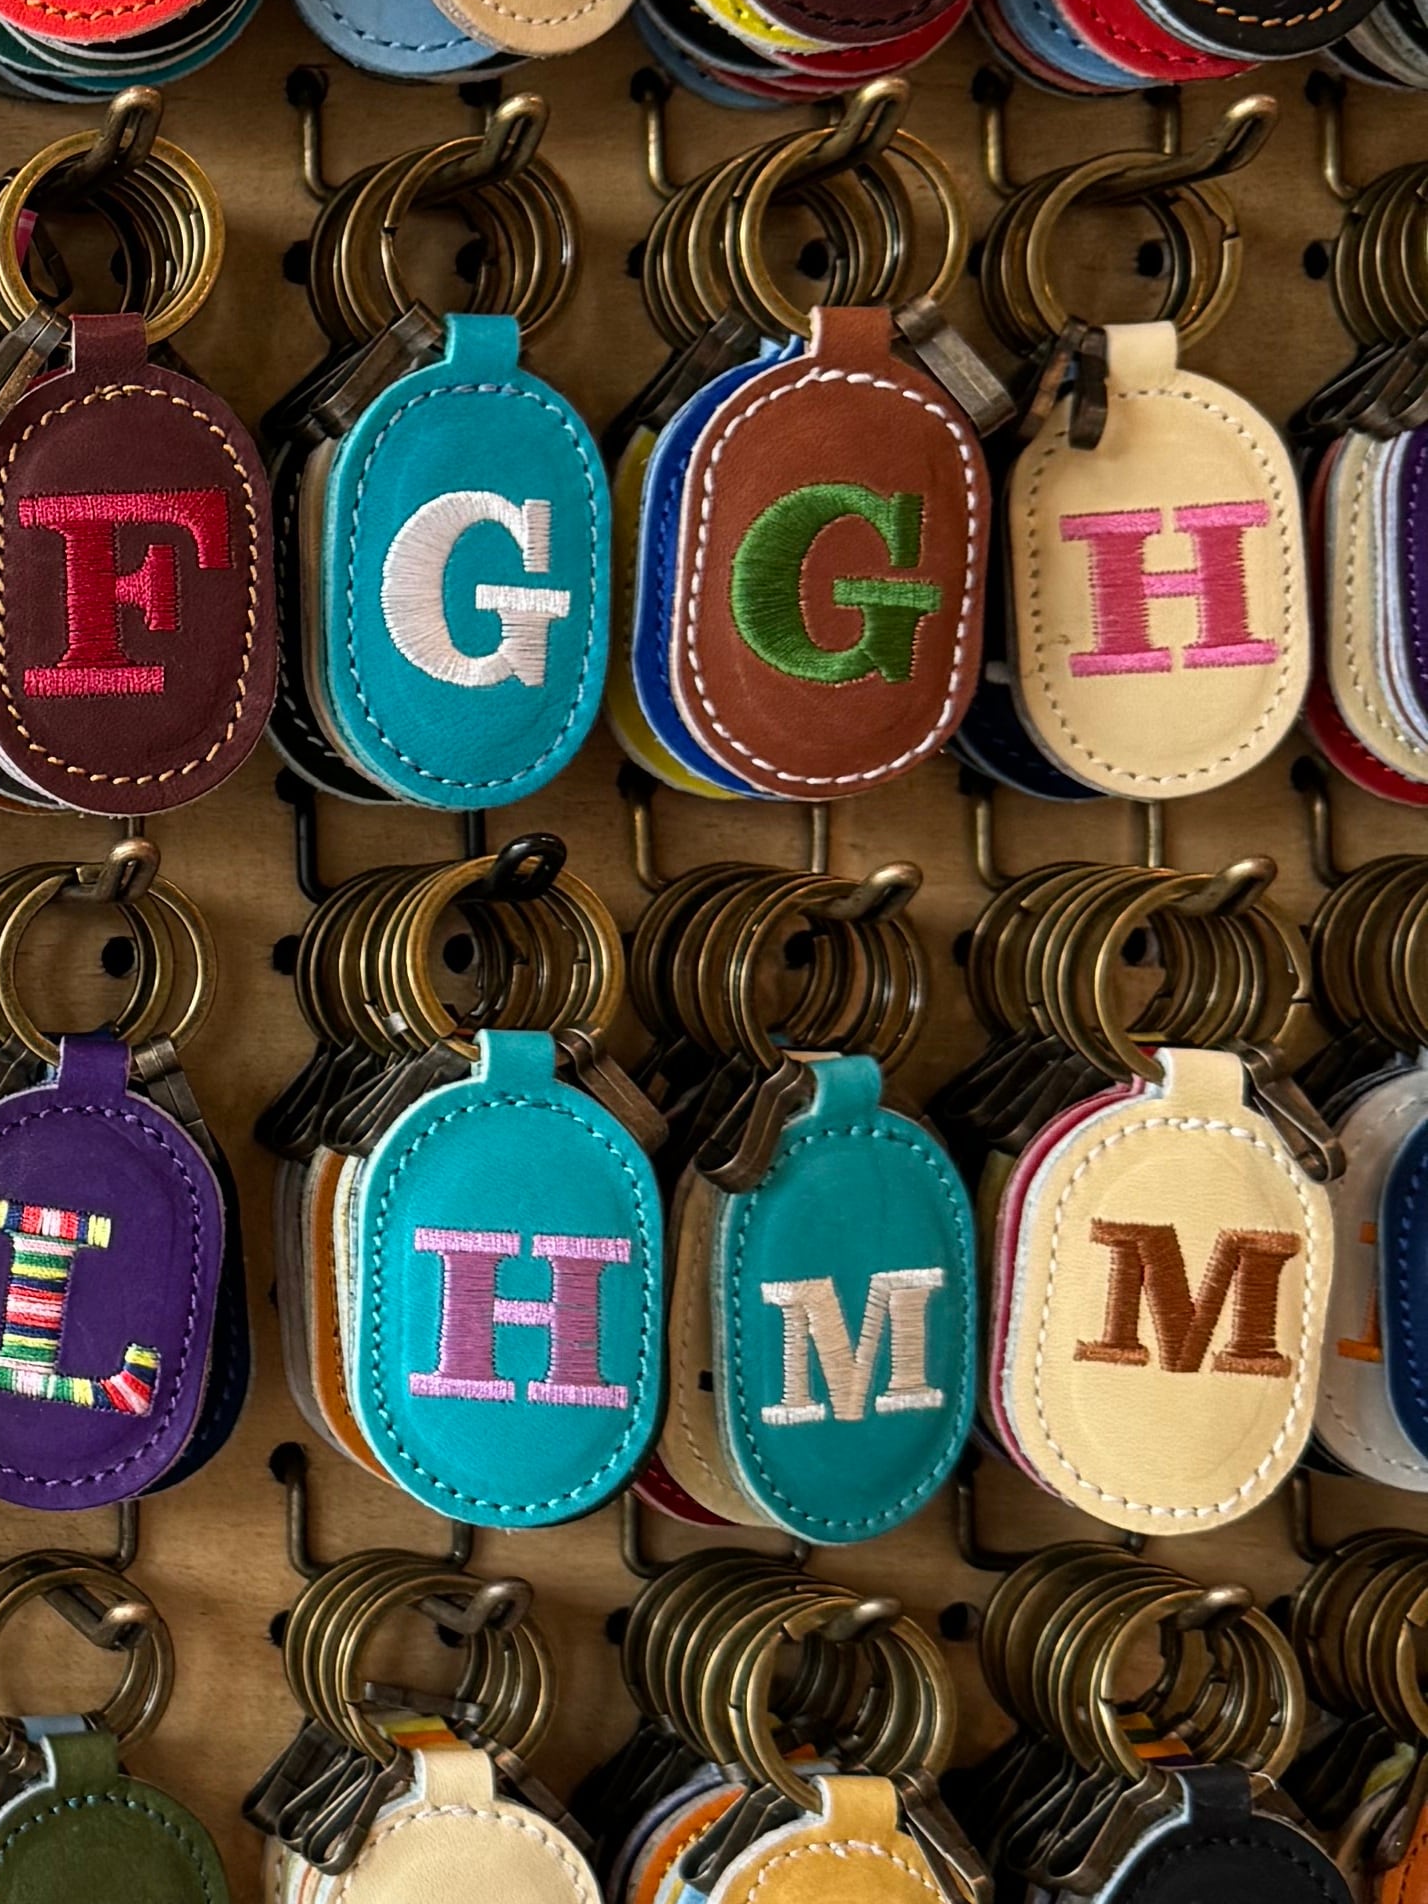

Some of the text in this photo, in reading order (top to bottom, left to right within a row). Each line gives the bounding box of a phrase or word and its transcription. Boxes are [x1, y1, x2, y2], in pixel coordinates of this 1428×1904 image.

[16, 488, 236, 698] F
[380, 489, 571, 688] G
[730, 482, 942, 685] G
[1059, 501, 1280, 677] H
[406, 1225, 633, 1409] H
[759, 1268, 944, 1424] M
[1074, 1217, 1301, 1377] M
